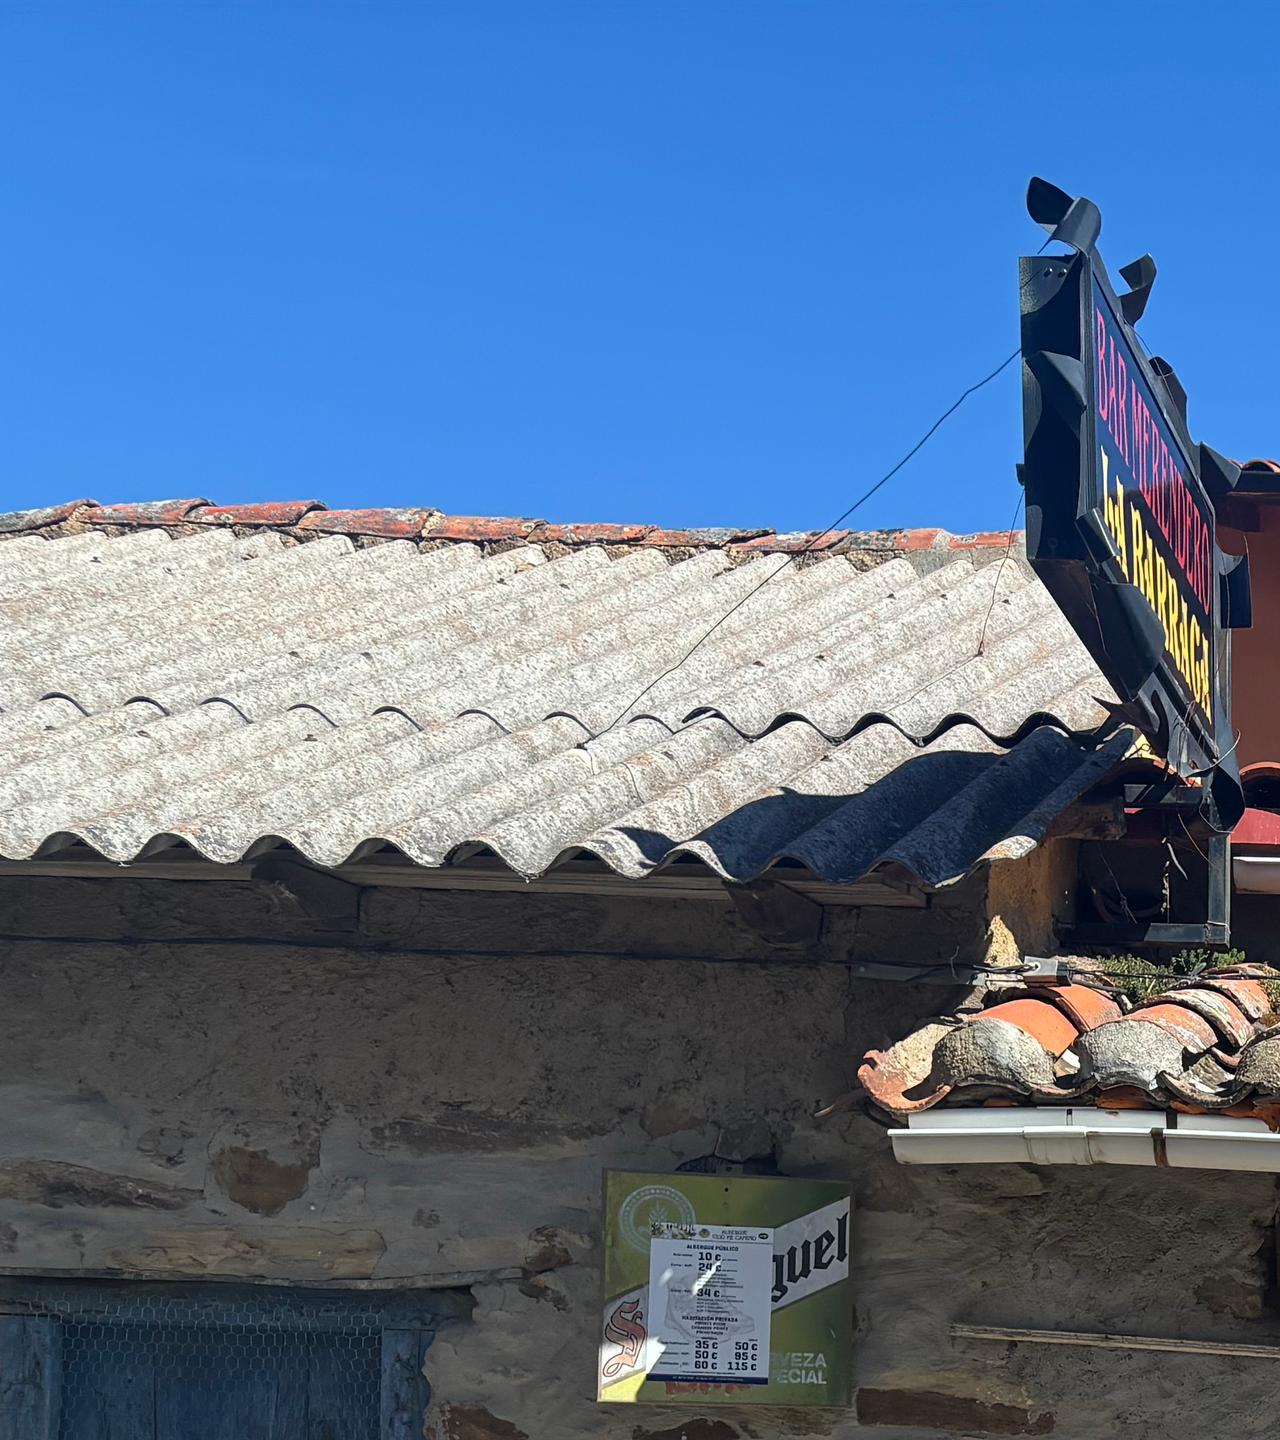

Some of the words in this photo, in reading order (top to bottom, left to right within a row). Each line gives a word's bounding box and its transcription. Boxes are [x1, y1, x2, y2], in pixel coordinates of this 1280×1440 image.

[1097, 308, 1129, 467] BAR
[1131, 378, 1211, 616] MERENDERO
[1100, 444, 1130, 583] LA
[698, 1252, 713, 1261] 10
[771, 1212, 848, 1302] guel
[698, 1262, 713, 1272] 24
[696, 1289, 711, 1298] 34
[695, 1340, 710, 1350] 35
[734, 1341, 749, 1351] 50
[694, 1350, 709, 1360] 50
[694, 1360, 708, 1370] 60
[727, 1361, 748, 1371] 115
